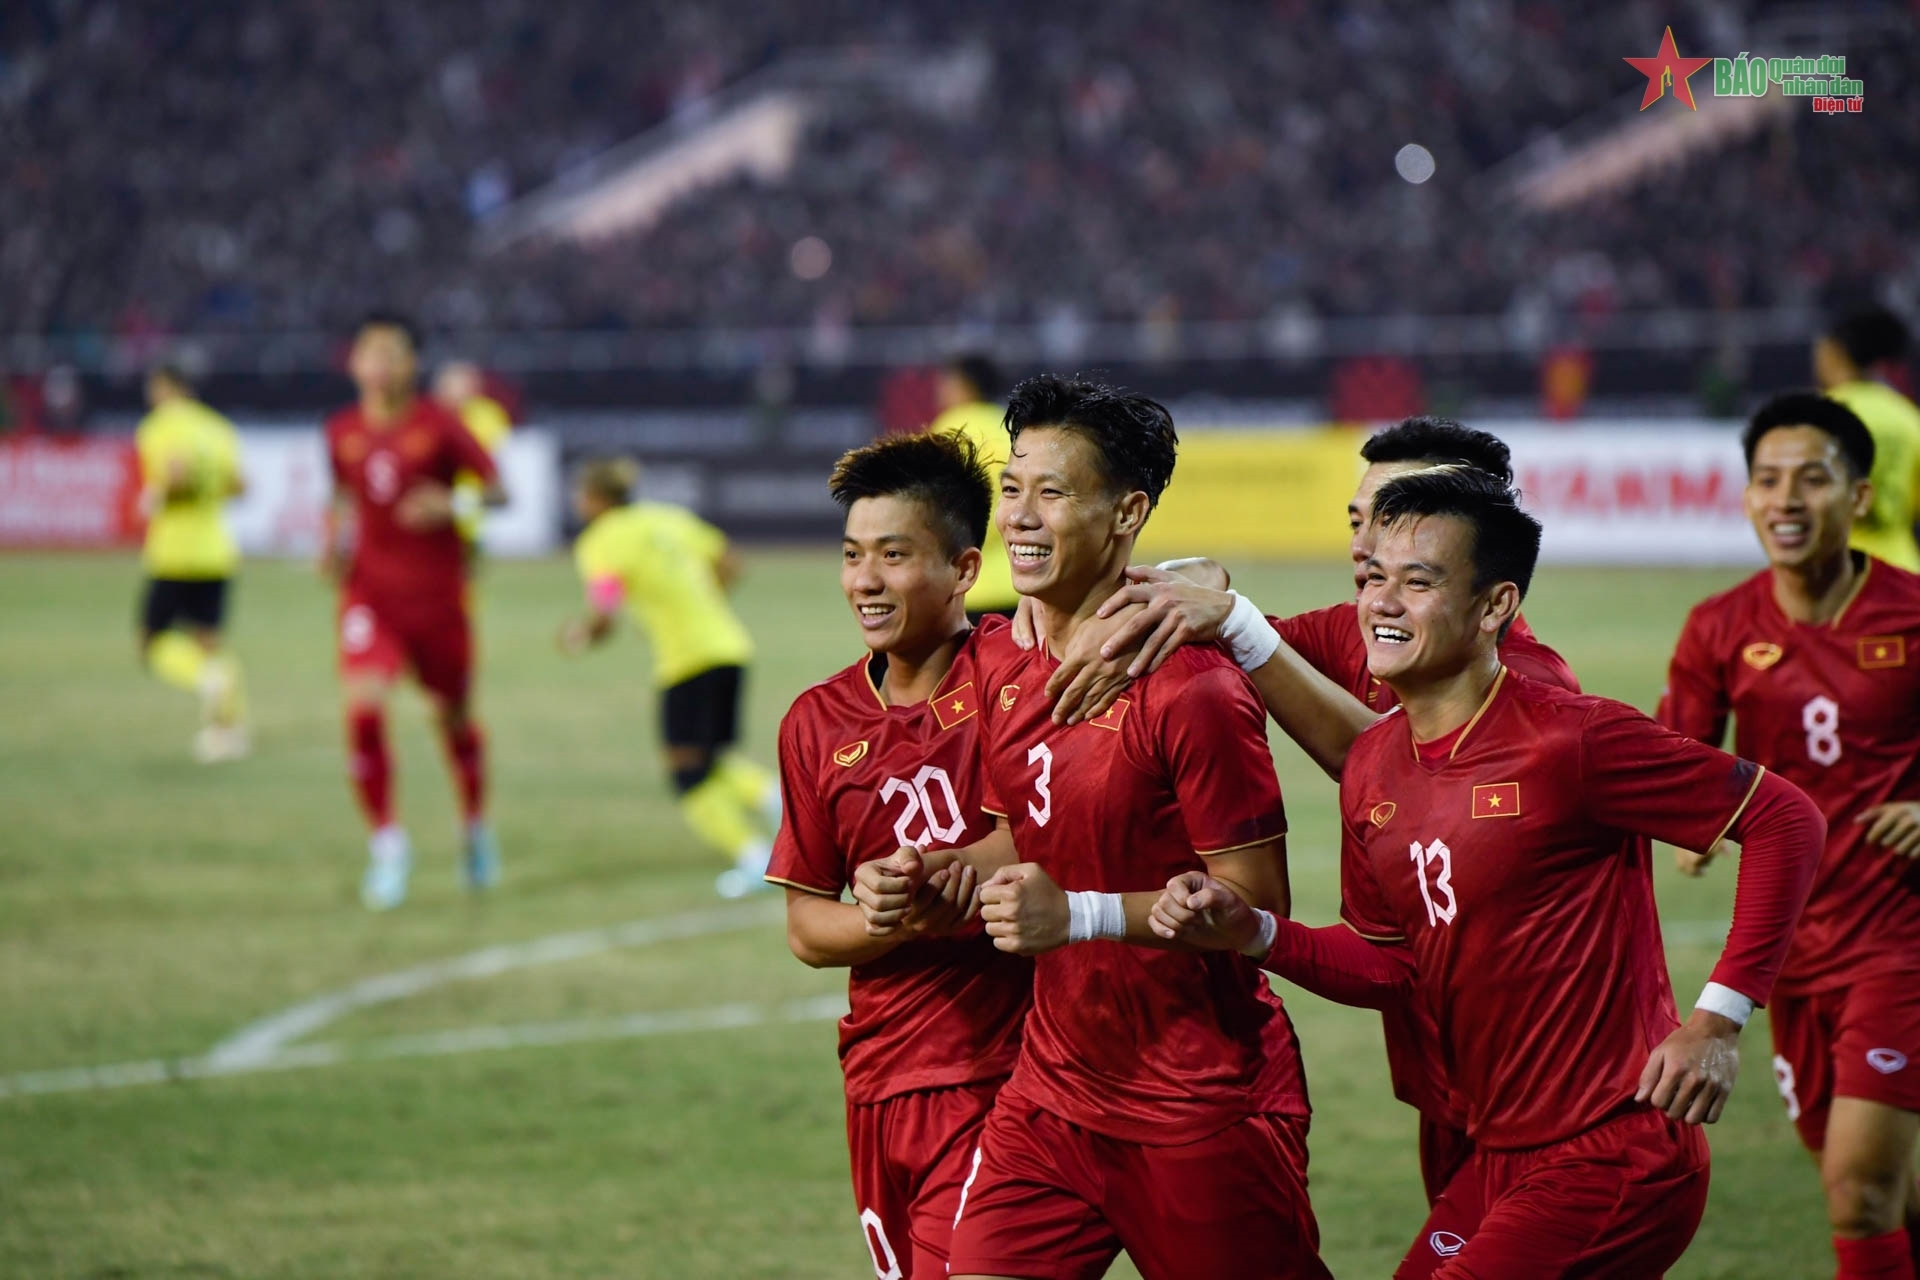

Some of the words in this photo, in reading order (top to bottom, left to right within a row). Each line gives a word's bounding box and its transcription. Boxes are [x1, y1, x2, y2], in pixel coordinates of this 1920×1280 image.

[1803, 695, 1842, 767] 8
[879, 765, 967, 847] 20
[1027, 742, 1053, 828] 3
[1410, 838, 1457, 927] 13
